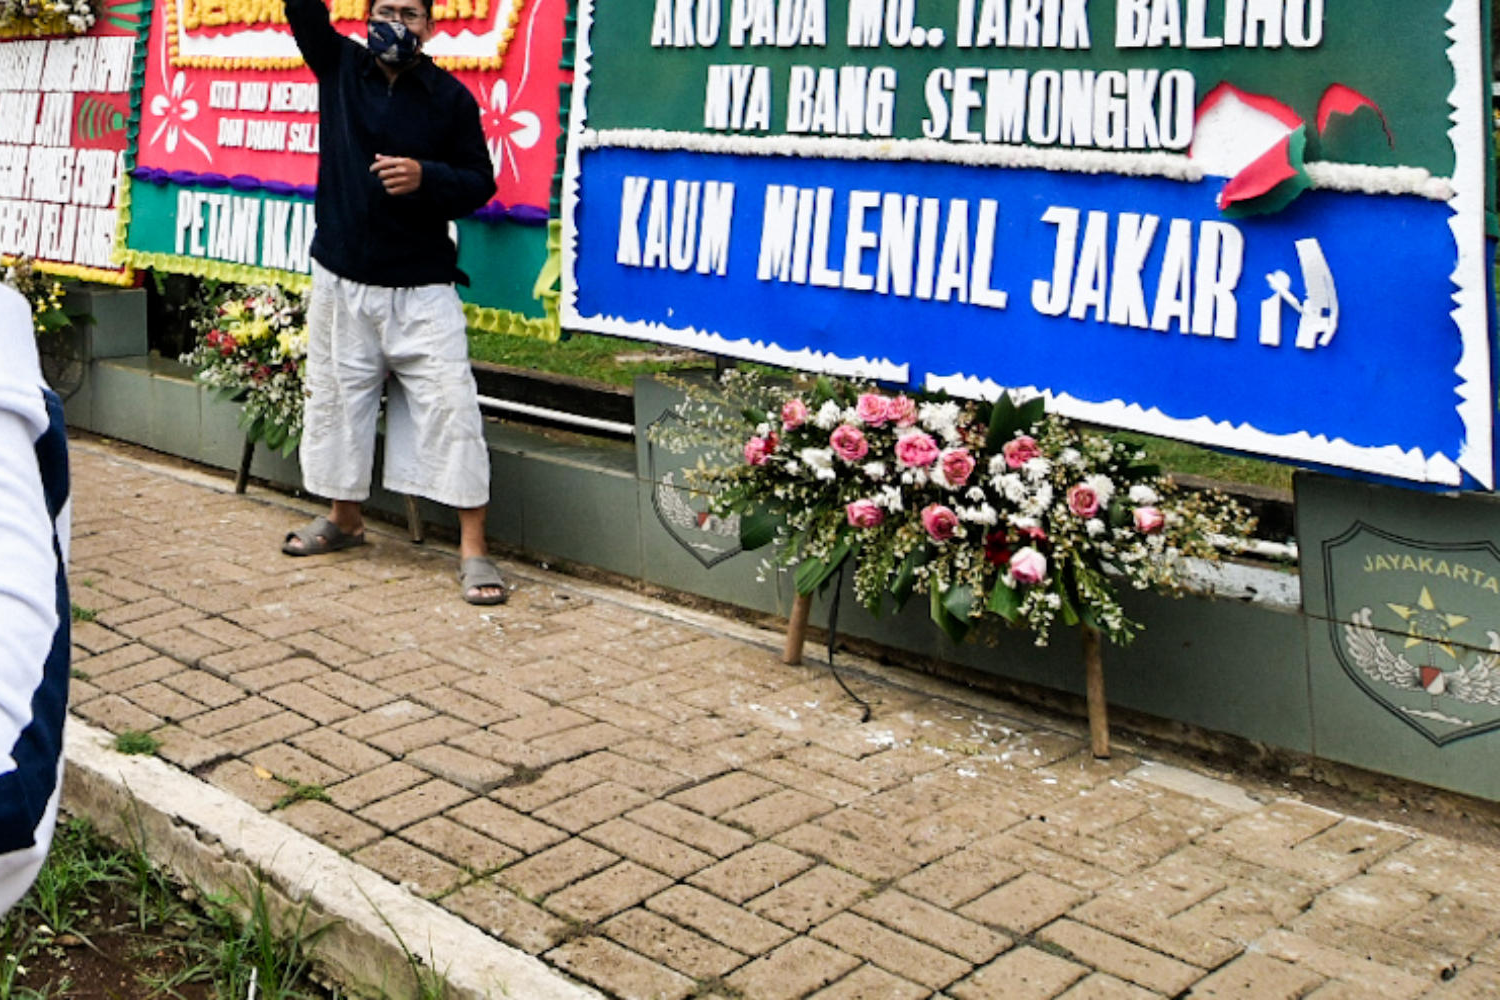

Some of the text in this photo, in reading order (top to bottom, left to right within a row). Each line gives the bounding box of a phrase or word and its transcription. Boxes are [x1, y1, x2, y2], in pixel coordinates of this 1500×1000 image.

[704, 64, 1197, 151] NYA BANG SEMONGKO
[175, 189, 261, 266] PETANI
[616, 176, 735, 277] KAUM
[757, 184, 1008, 309] MILENIAL
[1363, 553, 1500, 594] JAYAKARTA
